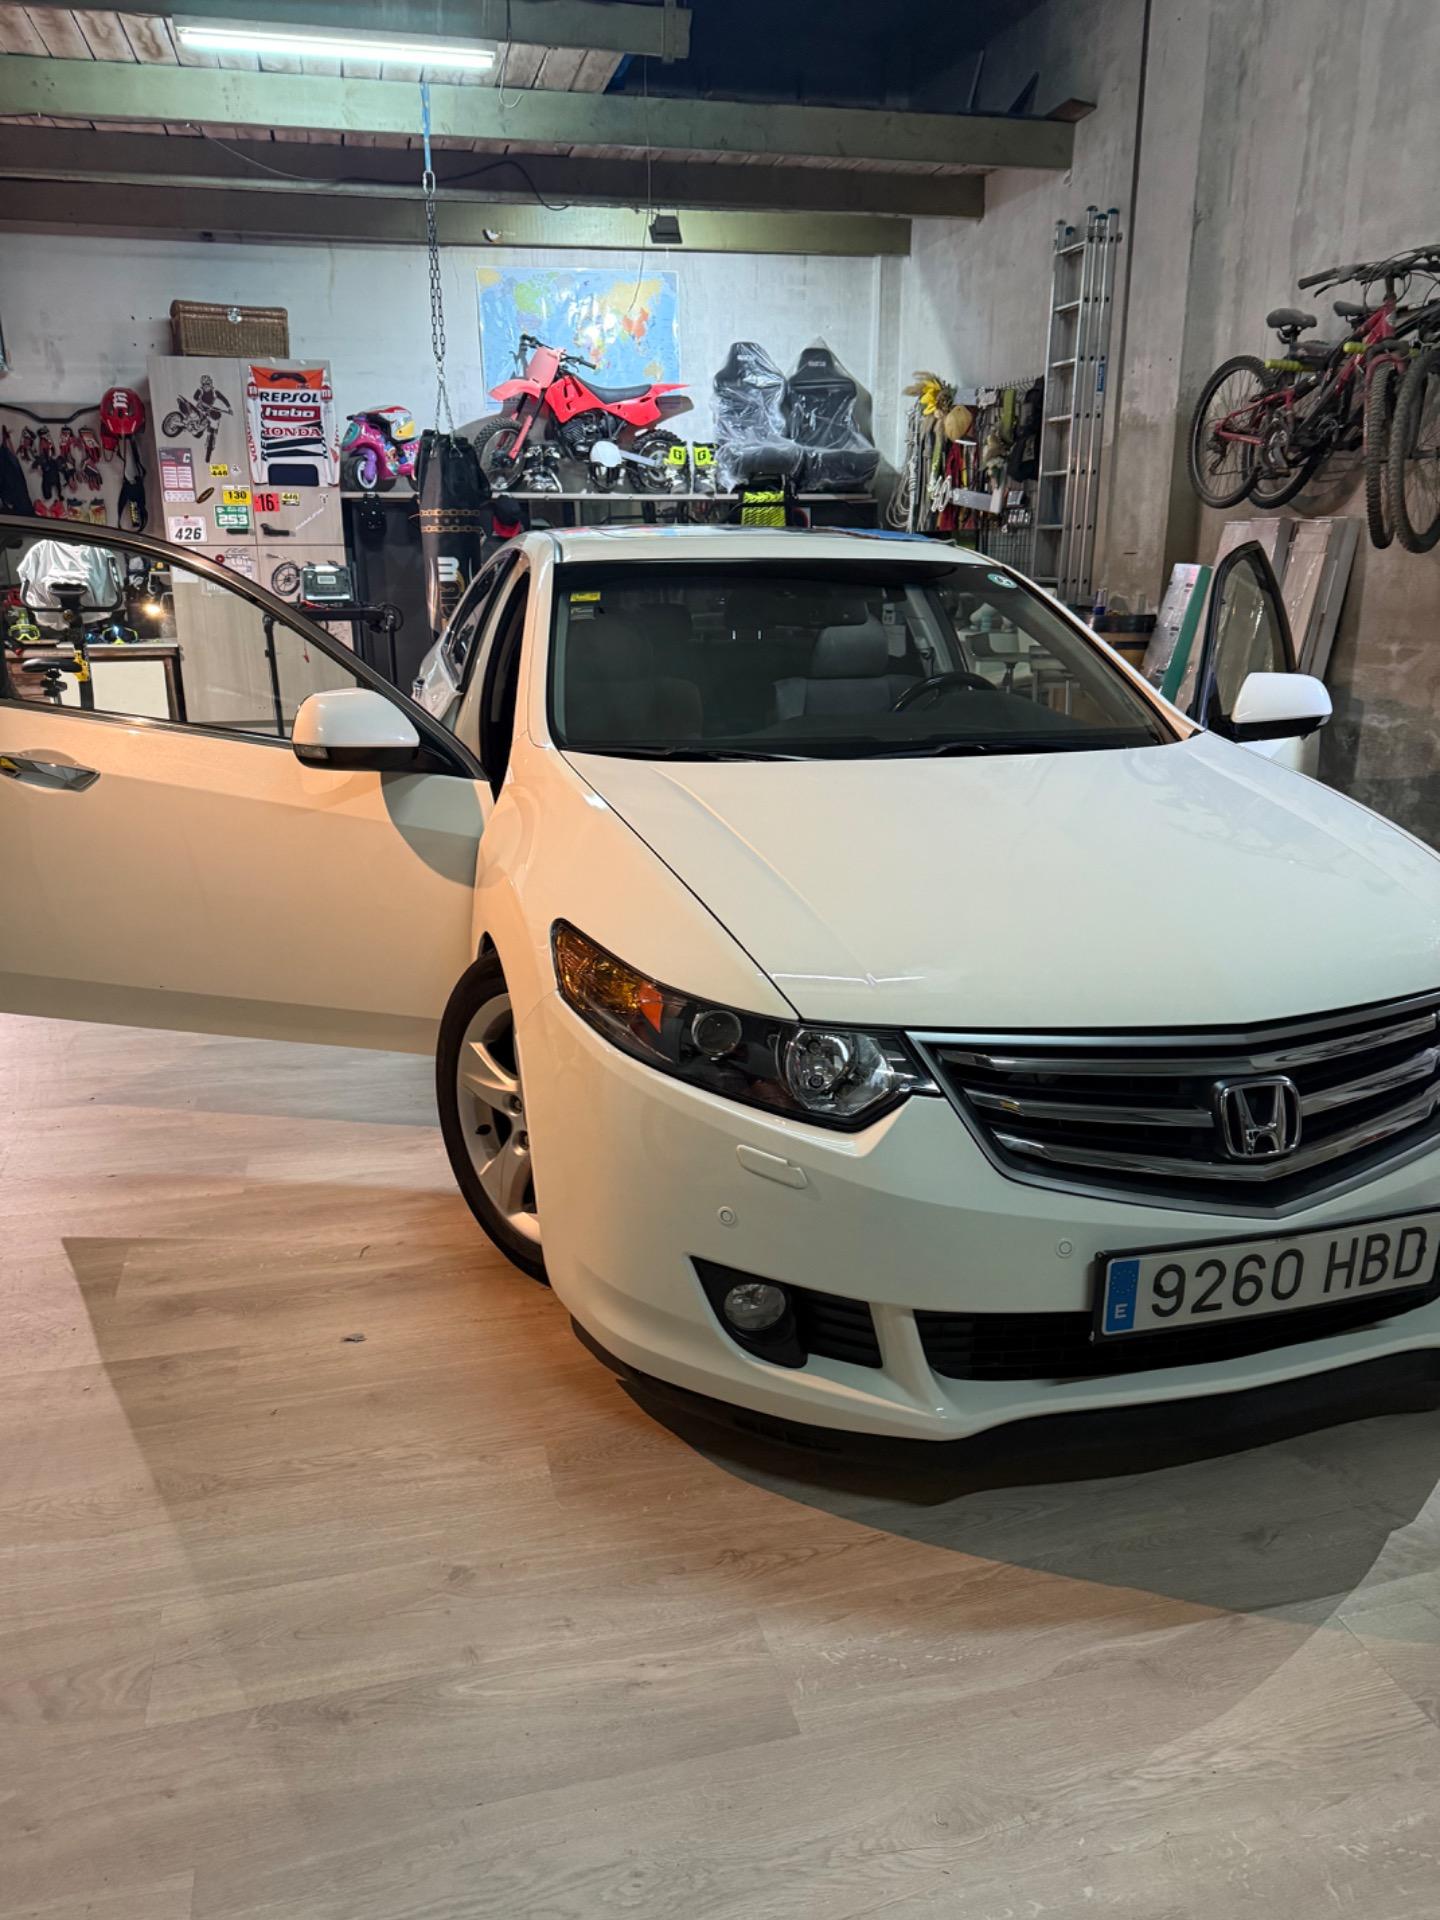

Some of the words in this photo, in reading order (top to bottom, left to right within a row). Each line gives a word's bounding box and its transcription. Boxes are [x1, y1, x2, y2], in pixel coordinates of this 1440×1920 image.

[259, 391, 320, 403] REPSOL
[264, 406, 316, 418] hebo
[696, 449, 707, 461] G
[227, 490, 247, 500] 130
[258, 492, 276, 512] 16
[218, 513, 248, 525] 253
[174, 527, 203, 541] 426
[1151, 1248, 1305, 1318] 9260
[1322, 1226, 1428, 1293] HBD
[1113, 1303, 1127, 1320] E
